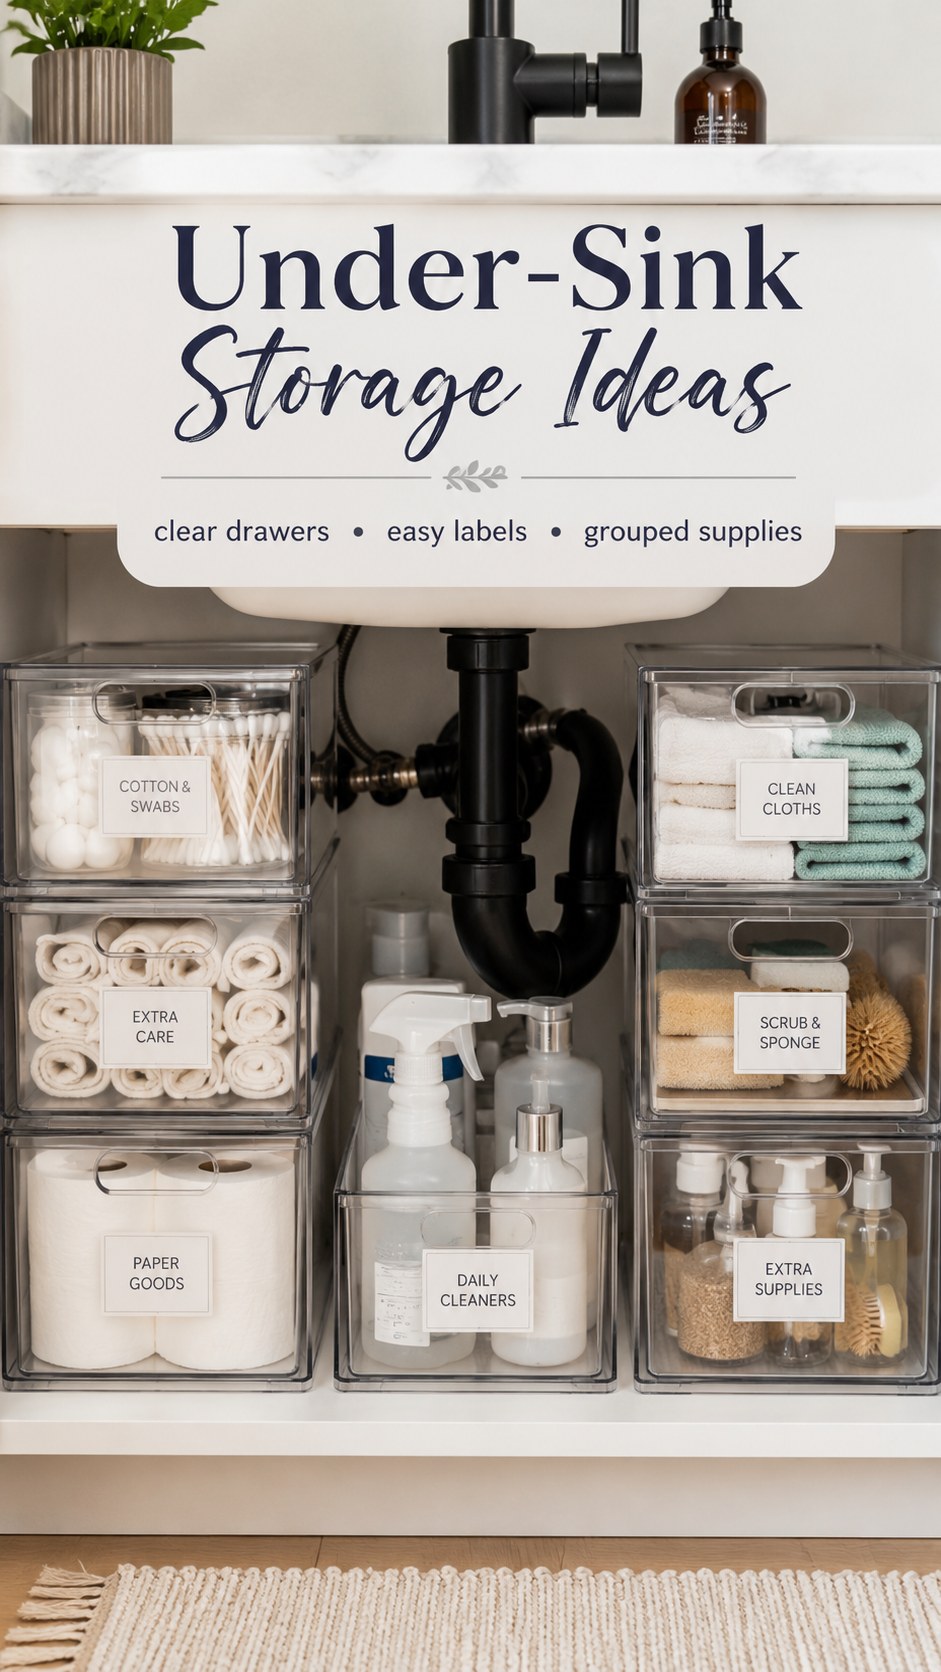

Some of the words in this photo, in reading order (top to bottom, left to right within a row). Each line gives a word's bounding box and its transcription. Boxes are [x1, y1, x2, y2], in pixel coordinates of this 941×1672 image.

[119, 780, 178, 793] COTTON
[181, 780, 191, 793] &
[767, 782, 816, 796] CLEAN
[130, 800, 180, 813] SWABS
[762, 802, 821, 816] CLOTHS
[132, 1010, 179, 1024] EXTRA
[760, 1016, 808, 1030] SCRUB
[811, 1016, 821, 1030] &
[136, 1030, 174, 1044] CARE
[760, 1036, 821, 1050] SPONGE
[133, 1256, 180, 1270] PAPER
[765, 1262, 813, 1276] EXTRA
[129, 1276, 185, 1291] GOODS
[457, 1273, 499, 1287] DAILY
[755, 1282, 823, 1296] SUPPLIES
[440, 1293, 516, 1307] CLEANERS
